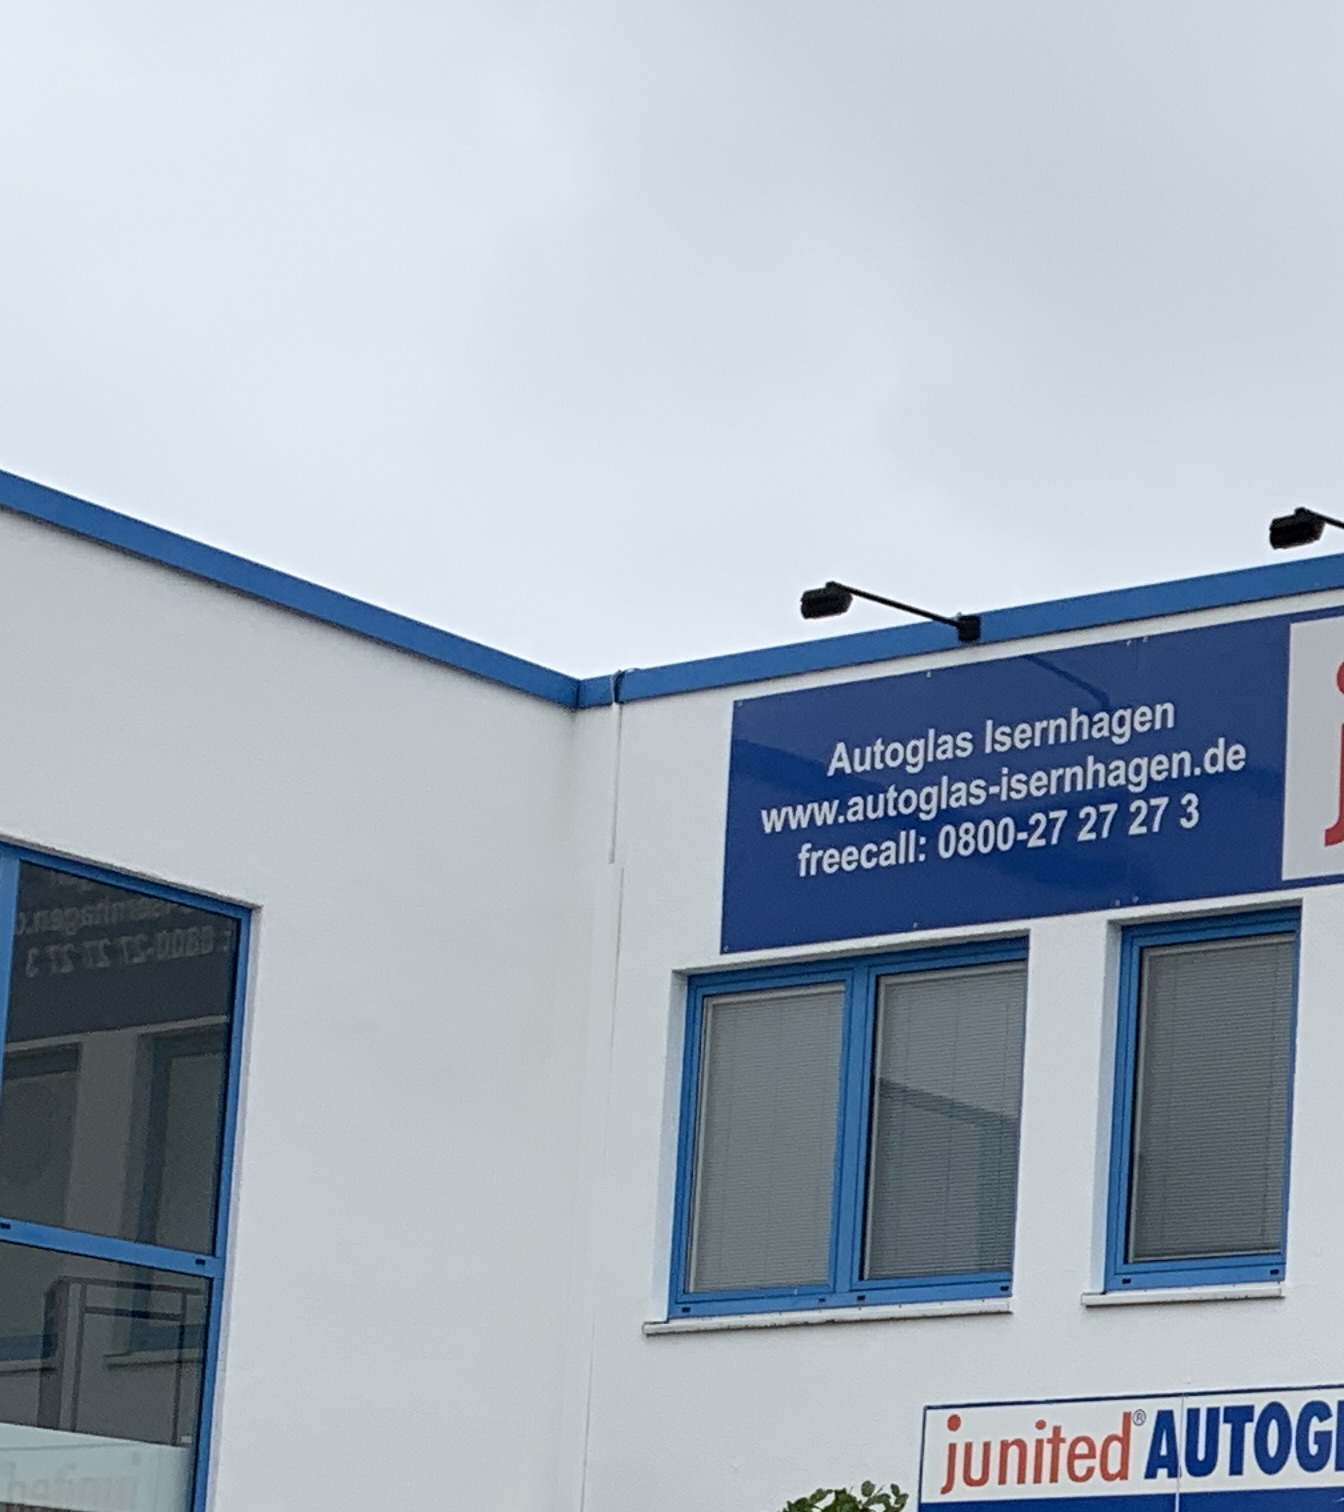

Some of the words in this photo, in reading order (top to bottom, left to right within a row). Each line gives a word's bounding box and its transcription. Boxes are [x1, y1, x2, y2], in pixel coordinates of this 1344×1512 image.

[828, 729, 973, 777] Autoglas
[985, 702, 1175, 754] Isernhagen
[761, 737, 1247, 833] www.autoglas-isernhagen.de
[798, 830, 926, 877] freecall:
[938, 810, 1068, 859] 0800-27
[1078, 804, 1118, 840] 27
[1129, 798, 1169, 836] 27
[1180, 793, 1200, 829] 3
